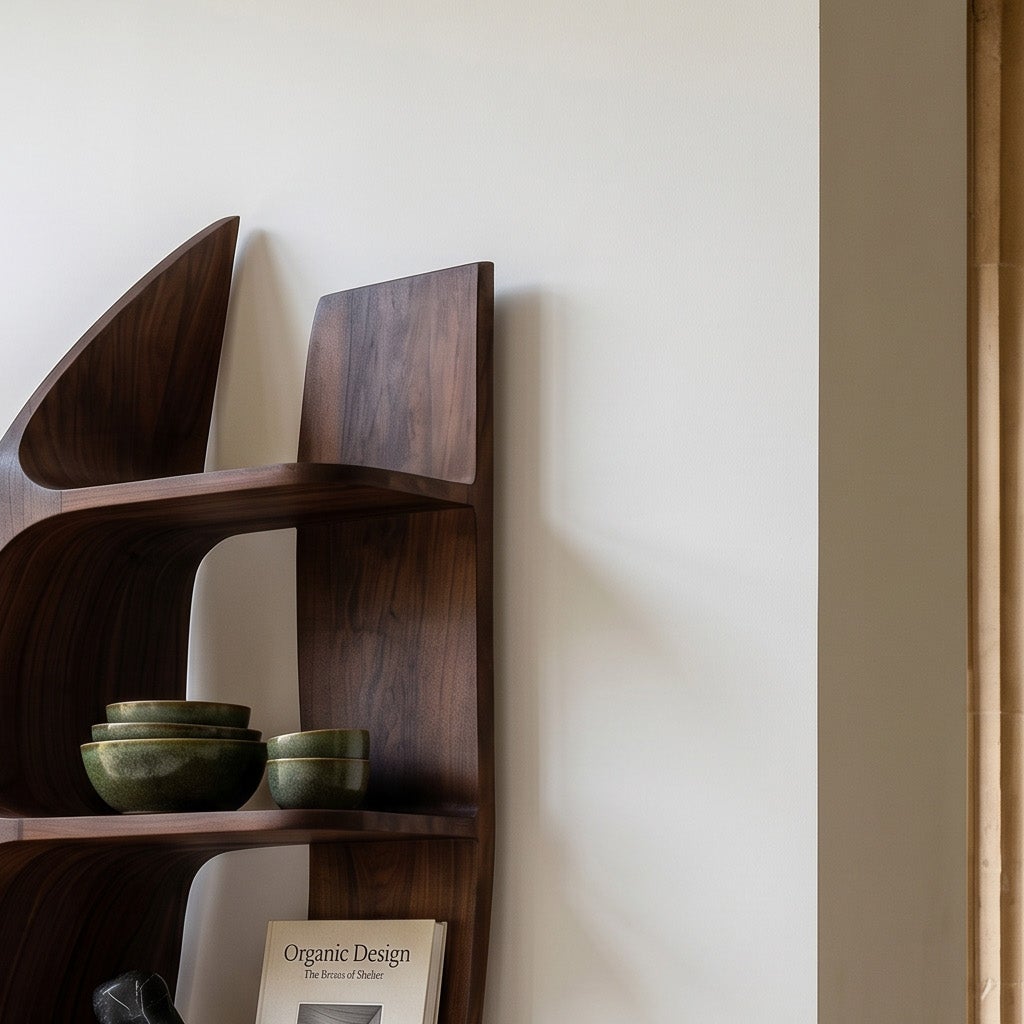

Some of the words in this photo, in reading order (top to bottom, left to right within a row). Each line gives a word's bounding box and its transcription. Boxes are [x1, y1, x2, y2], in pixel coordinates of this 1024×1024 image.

[284, 944, 349, 967] Organic
[353, 943, 410, 968] Design
[304, 970, 319, 979] The
[347, 970, 356, 979] of
